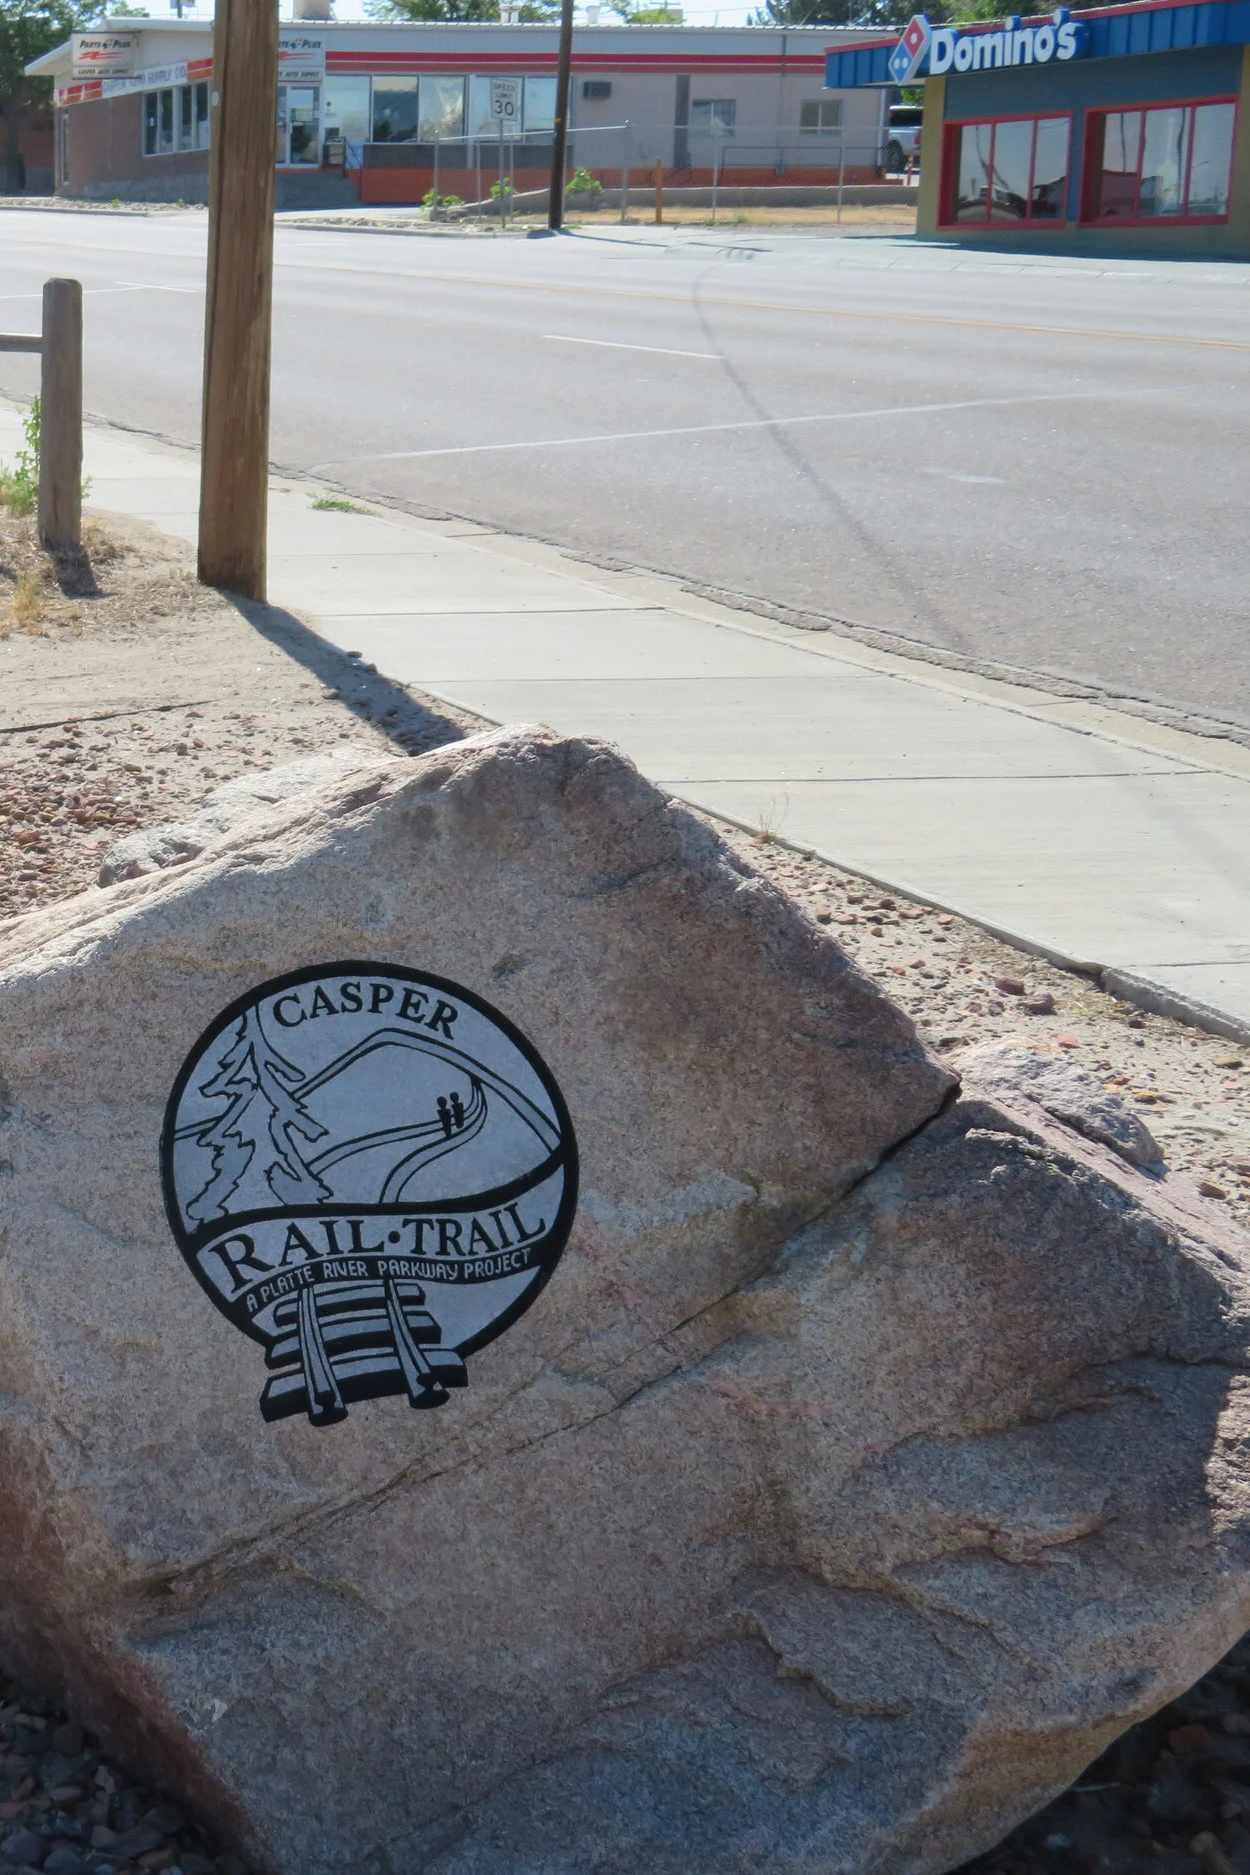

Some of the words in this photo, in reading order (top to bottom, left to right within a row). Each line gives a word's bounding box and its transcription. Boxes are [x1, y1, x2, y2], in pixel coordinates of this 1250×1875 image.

[930, 9, 1077, 75] Domino's
[494, 99, 515, 117] 30
[272, 981, 459, 1041] CASPER
[246, 1293, 259, 1313] A
[260, 1265, 316, 1303] PLATTE
[323, 1260, 369, 1279] RIVER
[378, 1259, 459, 1280] PARKWAY
[463, 1247, 532, 1280] PROJECT
